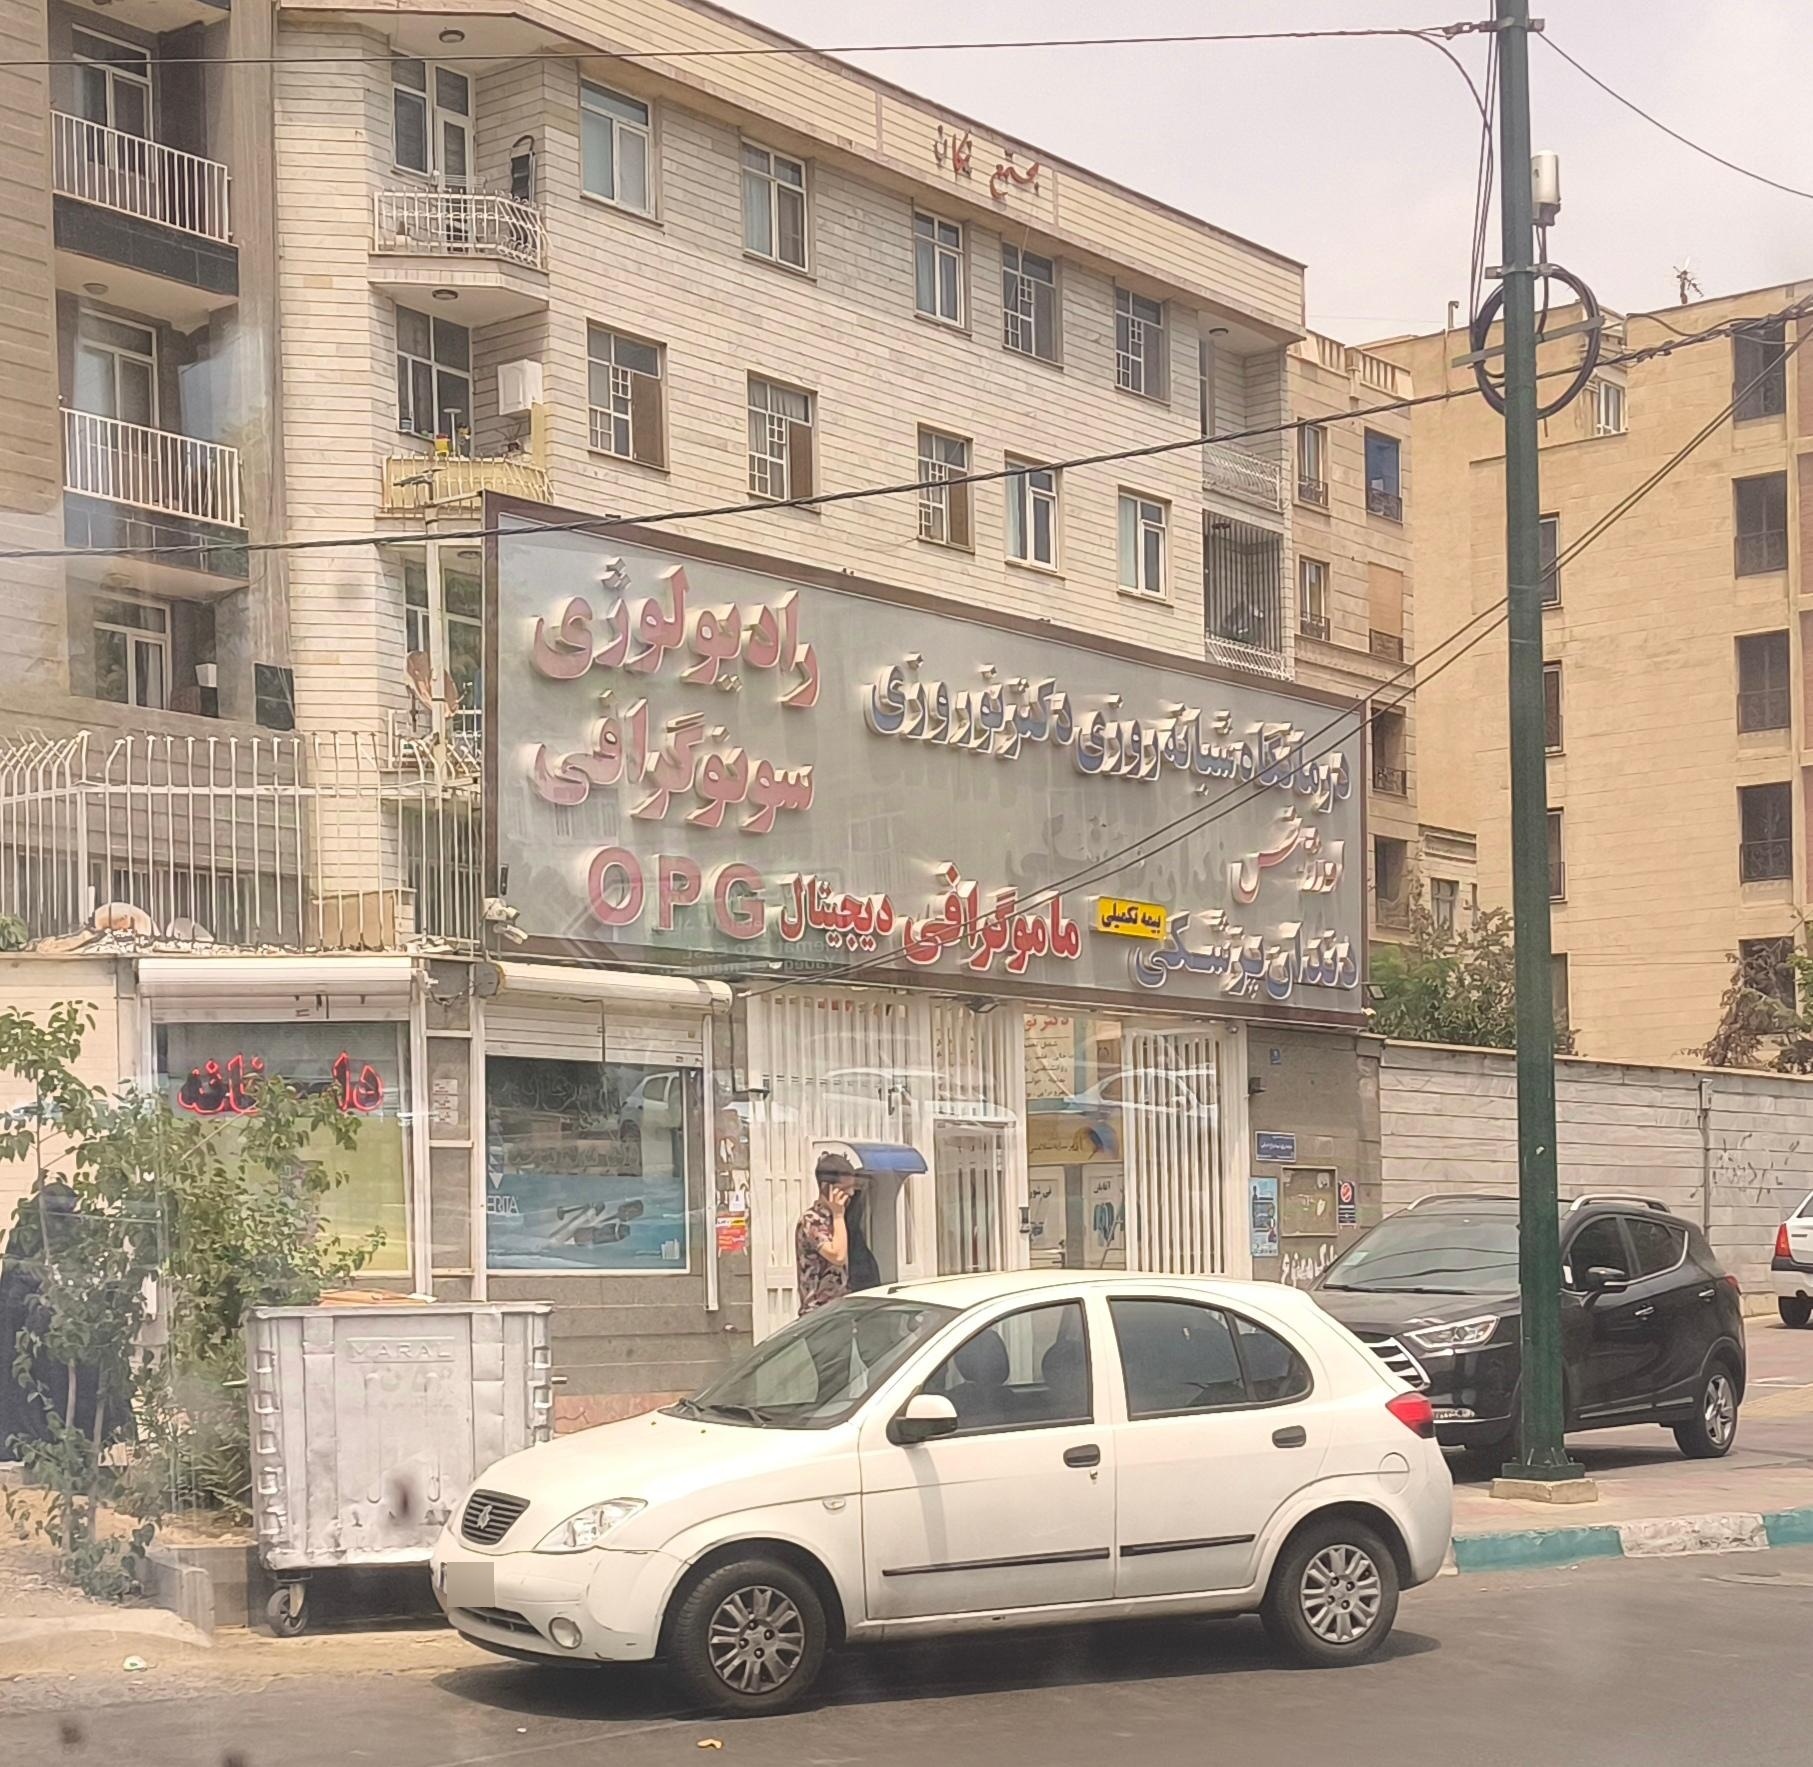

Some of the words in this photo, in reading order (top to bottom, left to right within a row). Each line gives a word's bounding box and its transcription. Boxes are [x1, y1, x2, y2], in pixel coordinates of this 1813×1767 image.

[529, 557, 821, 708] رادیولوژی
[863, 651, 1003, 755] نوروزی
[996, 676, 1073, 760] دکتر
[527, 689, 815, 833] سونوگرافی
[1240, 721, 1351, 814] درمانگاه
[583, 845, 767, 939] OPG
[776, 872, 897, 951] دیجیتال
[902, 861, 1082, 974] ماموگرافی
[1101, 902, 1139, 928] تکمیلی
[1141, 911, 1161, 934] بیمه
